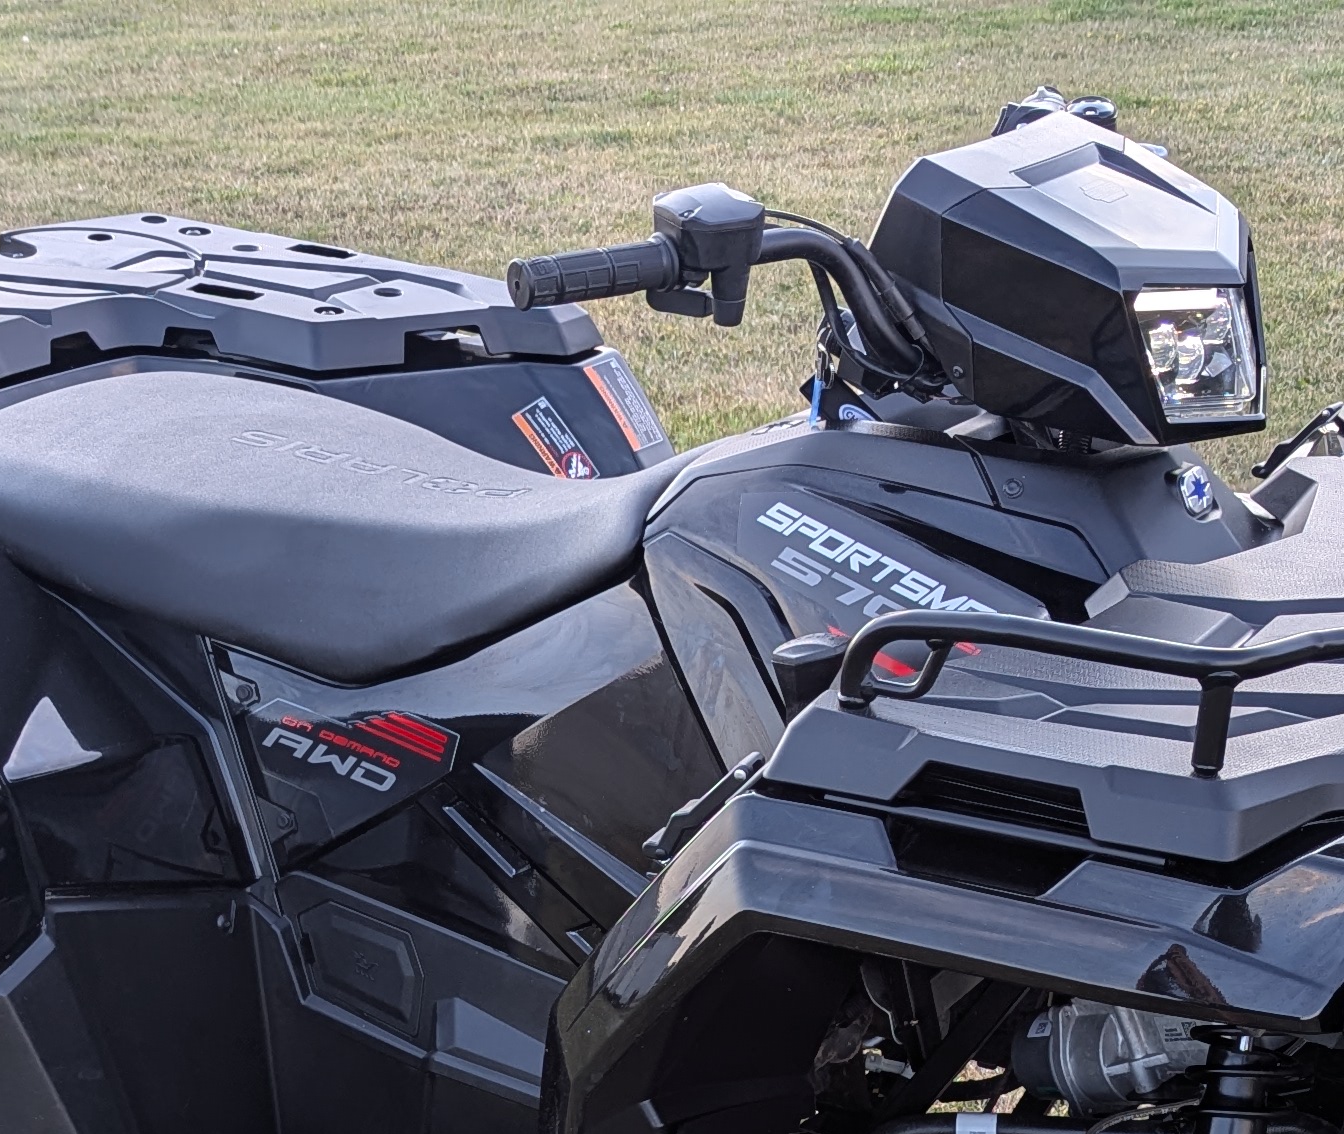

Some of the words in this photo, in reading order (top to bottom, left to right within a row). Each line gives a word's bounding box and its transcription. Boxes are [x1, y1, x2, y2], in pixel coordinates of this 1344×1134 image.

[231, 429, 533, 498] POLARIS
[528, 433, 557, 469] WARNING
[756, 501, 998, 614] SPORTSM
[261, 727, 397, 792] AWD
